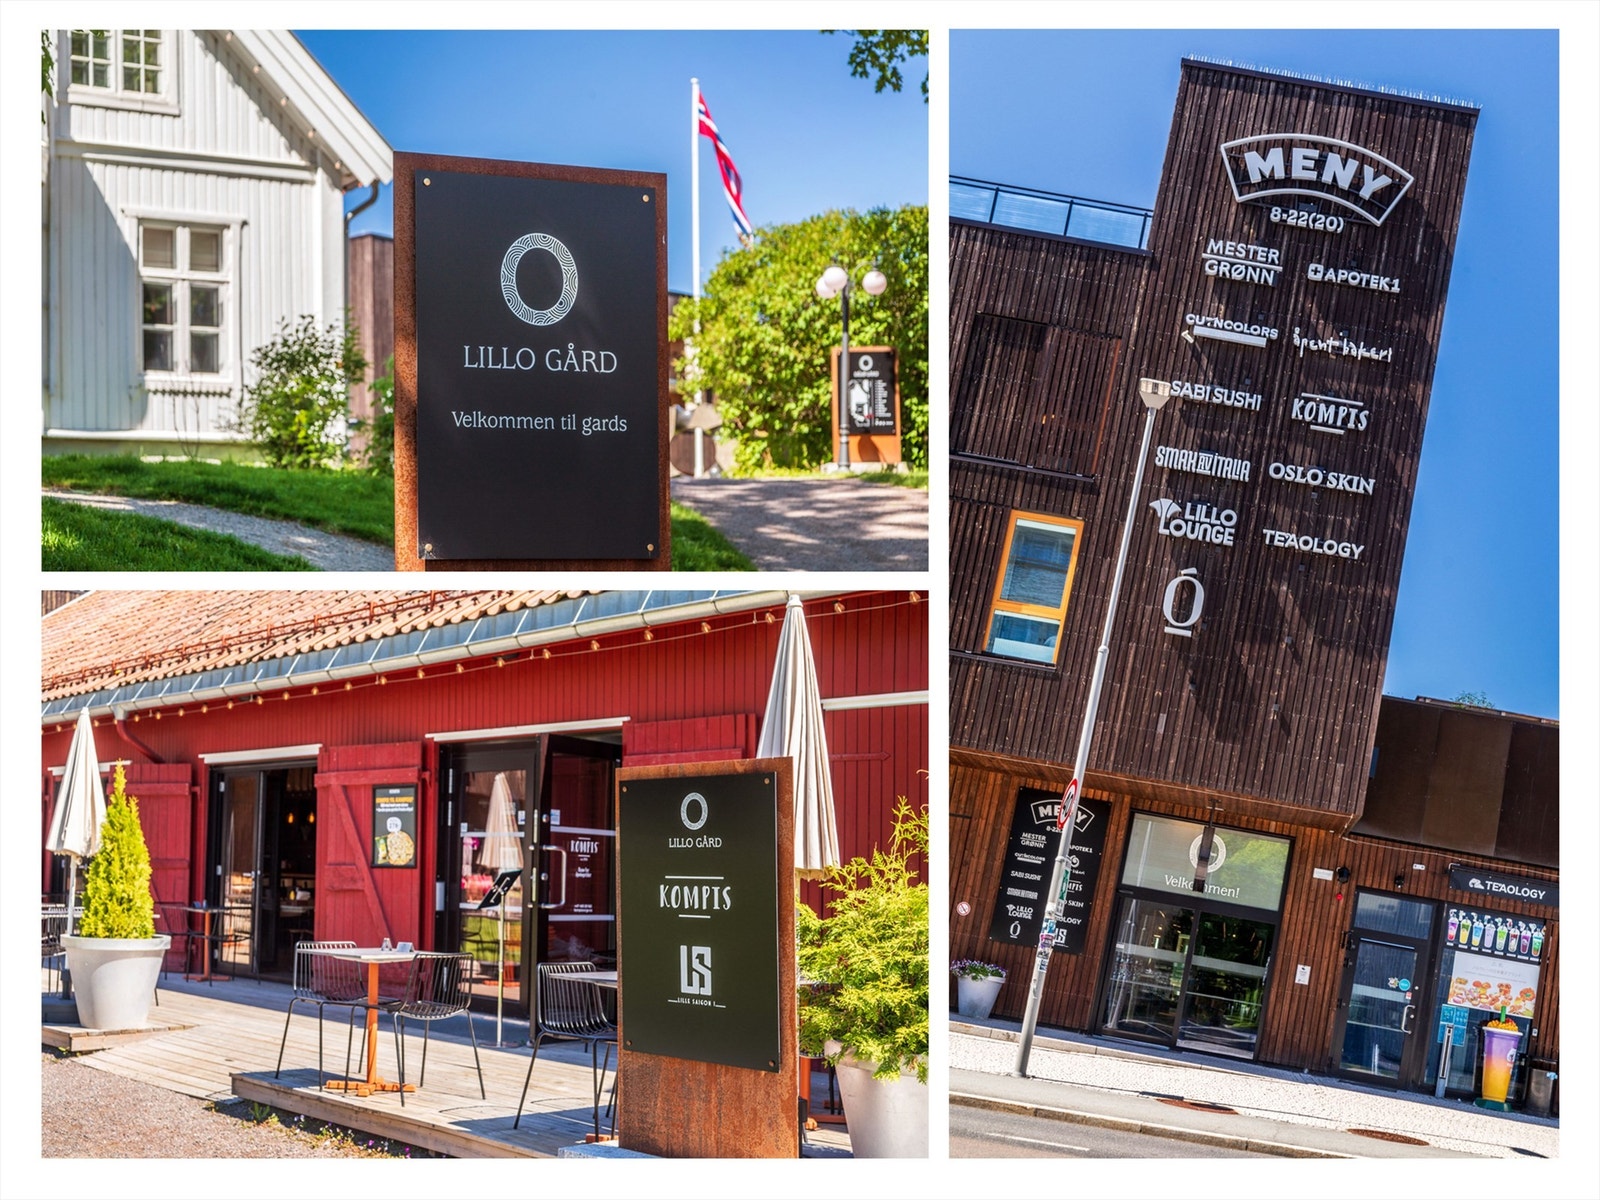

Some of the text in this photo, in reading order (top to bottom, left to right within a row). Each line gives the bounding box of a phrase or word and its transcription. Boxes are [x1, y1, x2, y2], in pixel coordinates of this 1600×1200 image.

[1244, 147, 1392, 200] MENY
[1270, 206, 1344, 234] 8-22(20)
[1207, 238, 1280, 265] MESTER
[1205, 259, 1275, 286] GRØNN
[464, 342, 618, 374] LILLO GÅRD
[1170, 380, 1262, 411] SABI SUSHI
[451, 410, 628, 436] Velkommen til gards
[1291, 398, 1369, 432] KOMPIS
[1268, 462, 1376, 496] OSLO SKIN
[1184, 502, 1237, 527] LILLO
[1262, 528, 1365, 560] TEAOLOGY
[1038, 804, 1088, 823] MEY
[668, 834, 722, 848] LILLO GÅRD
[1020, 840, 1044, 849] GRØNN
[1021, 832, 1046, 841] MESTER
[1010, 870, 1024, 878] SABI
[659, 884, 732, 911] KOMPIS
[1485, 880, 1546, 900] TEAOLOGY
[1016, 905, 1034, 913] LILLO
[1068, 900, 1084, 908] SKIN
[692, 999, 712, 1007] SAIGON
